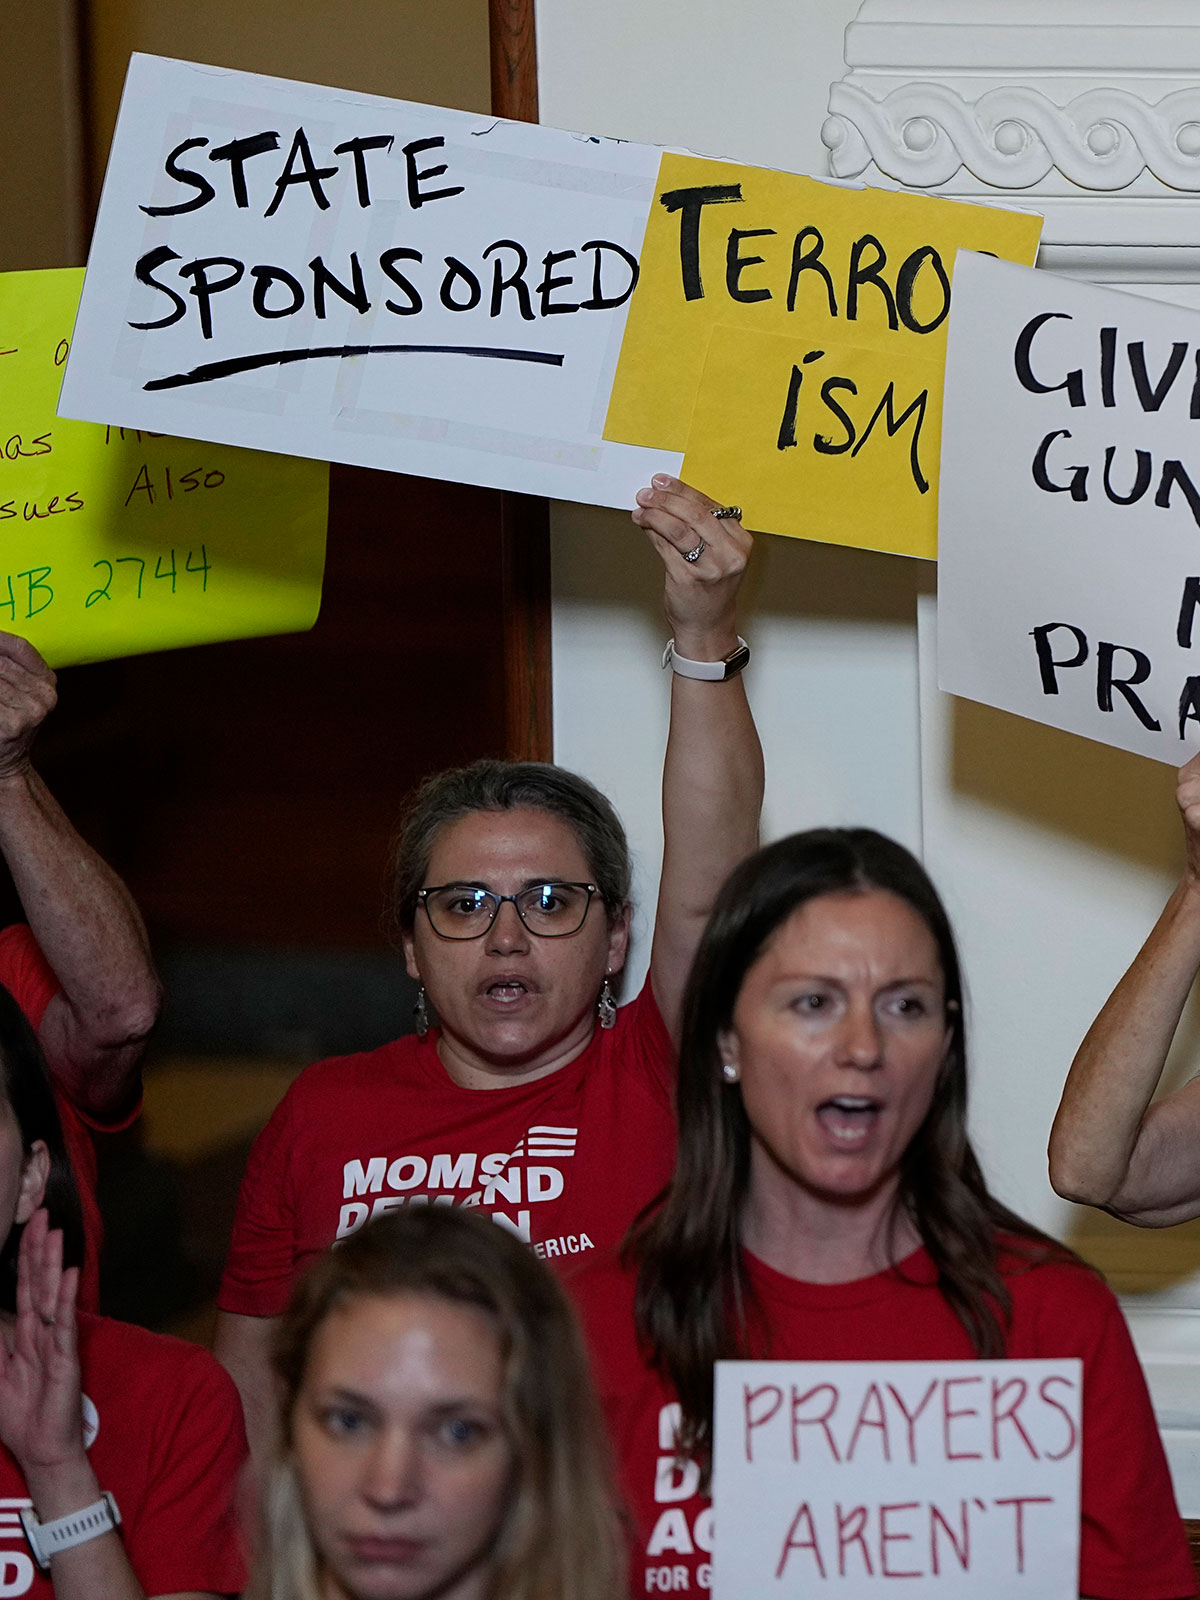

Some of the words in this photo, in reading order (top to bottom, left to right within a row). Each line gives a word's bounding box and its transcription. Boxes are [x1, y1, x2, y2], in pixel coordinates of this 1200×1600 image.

[139, 128, 465, 217] STATE
[128, 239, 640, 339] SPONSORED
[660, 183, 999, 335] TERRO
[0, 433, 52, 459] as
[85, 544, 212, 609] 2744
[343, 1153, 512, 1198] MOMS
[743, 1375, 1078, 1465] PRAYERS
[645, 1564, 690, 1593] FOR
[776, 1496, 1053, 1579] AREN'T
